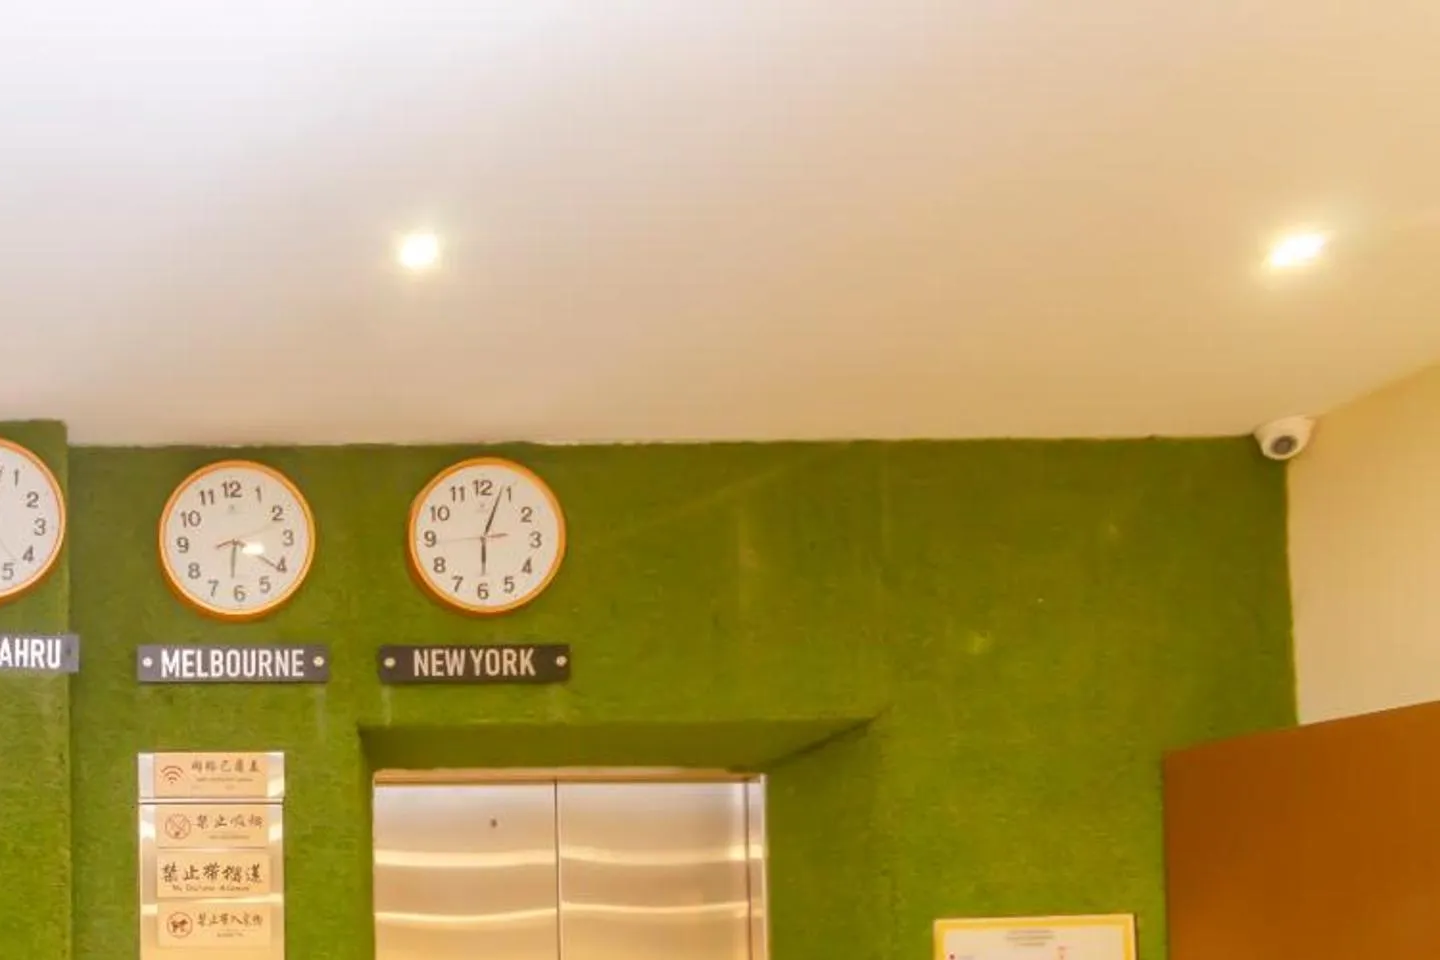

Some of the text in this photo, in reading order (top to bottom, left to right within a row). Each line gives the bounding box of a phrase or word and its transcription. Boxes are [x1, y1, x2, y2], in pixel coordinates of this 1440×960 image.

[222, 481, 242, 498] 12
[450, 486, 465, 502] 11
[473, 480, 493, 496] 12
[26, 492, 39, 508] 2
[199, 490, 214, 505] 11
[180, 510, 201, 528] 10
[272, 505, 284, 521] 2
[431, 506, 449, 521] 10
[521, 507, 532, 523] 2
[34, 519, 46, 536] 3
[177, 536, 189, 553] 9
[283, 530, 294, 546] 3
[424, 530, 437, 548] 9
[530, 532, 542, 548] 3
[22, 546, 34, 562] 4
[2, 562, 14, 580] 5
[188, 563, 201, 579] 8
[276, 557, 287, 572] 4
[433, 557, 446, 573] 8
[522, 558, 532, 574] 4
[208, 580, 219, 597] 7
[259, 576, 271, 593] 5
[452, 576, 463, 592] 7
[477, 583, 489, 599] 6
[504, 576, 514, 593] 5
[233, 585, 245, 602] 6
[160, 649, 304, 677] MELBOURNE
[413, 649, 537, 678] NEW YORK
